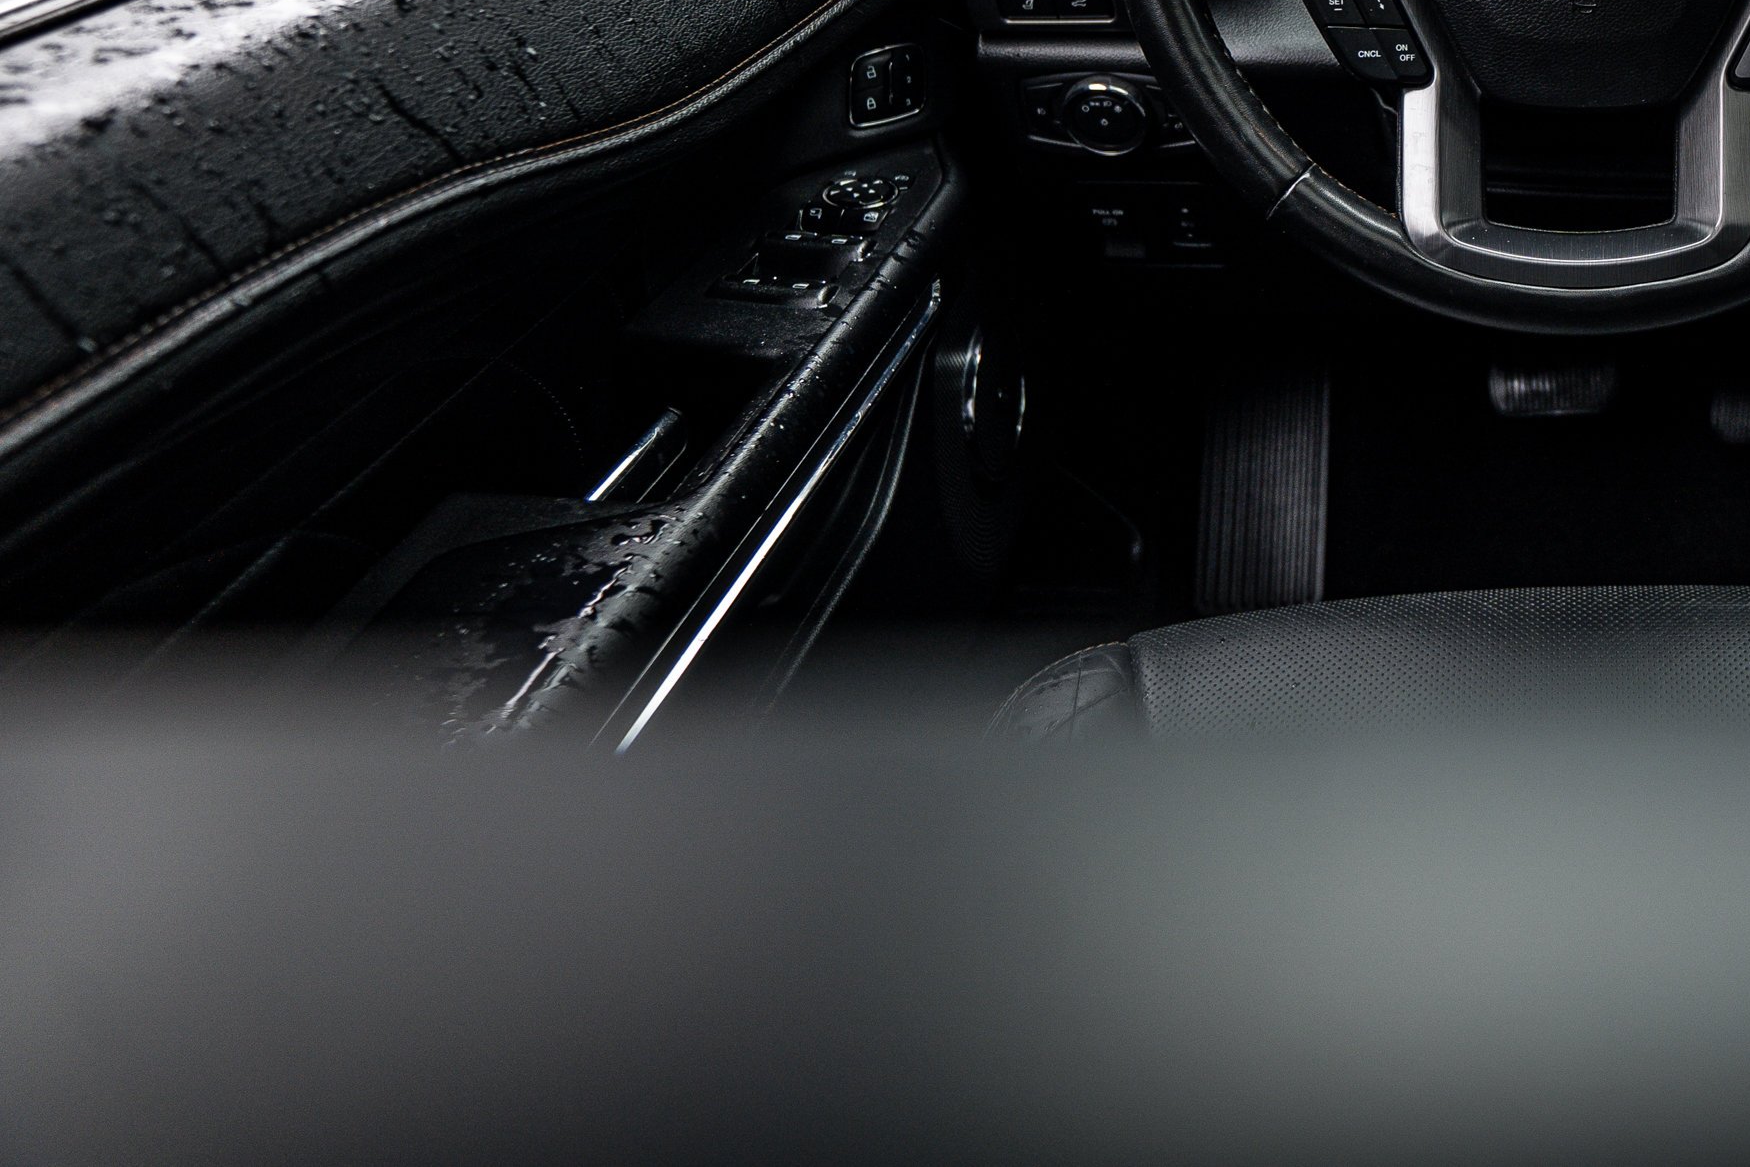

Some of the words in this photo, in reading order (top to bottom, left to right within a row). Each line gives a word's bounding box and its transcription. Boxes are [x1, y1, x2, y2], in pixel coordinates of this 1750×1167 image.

[1395, 44, 1408, 52] ON
[1358, 50, 1382, 58] CNCL
[1399, 54, 1416, 62] OFF
